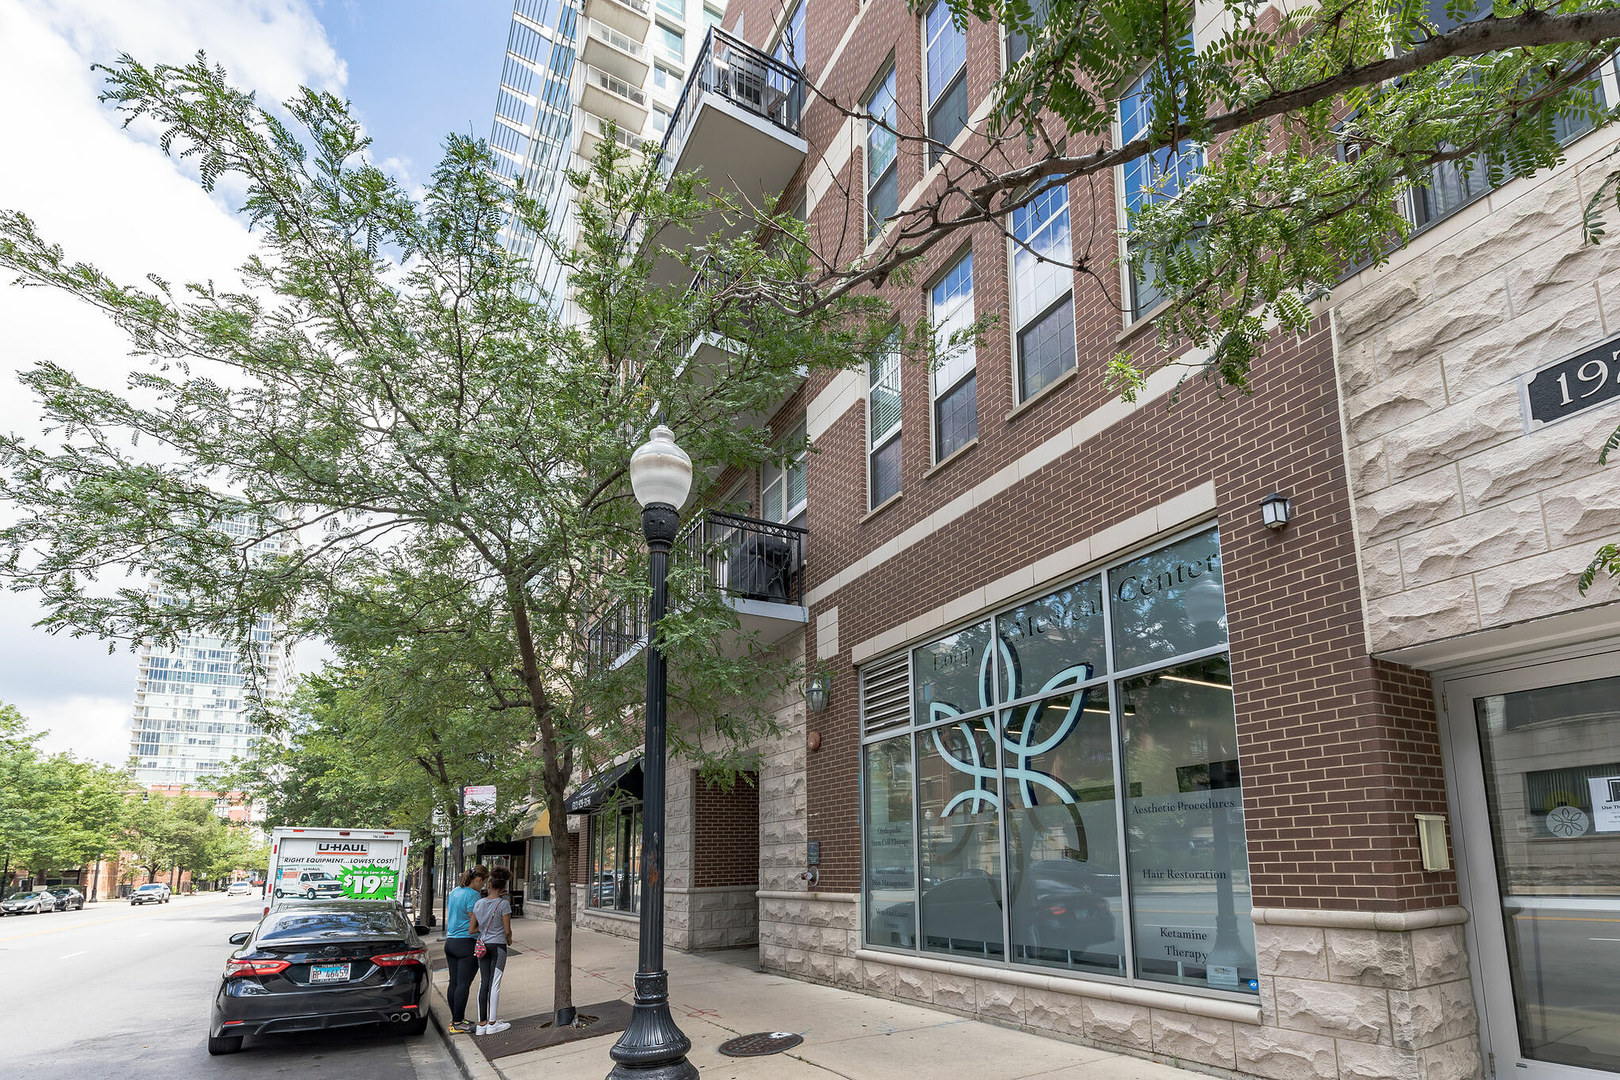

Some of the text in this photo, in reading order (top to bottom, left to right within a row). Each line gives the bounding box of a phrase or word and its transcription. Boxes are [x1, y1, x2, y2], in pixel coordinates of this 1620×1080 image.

[932, 647, 974, 671] Loop
[1118, 553, 1218, 602] Center
[1132, 798, 1235, 815] Aesthetic Procedures
[318, 843, 367, 852] U-HAUL
[1142, 869, 1227, 880] Hair Restoration
[1160, 927, 1207, 940] Ketamine
[1164, 945, 1208, 963] Therapy
